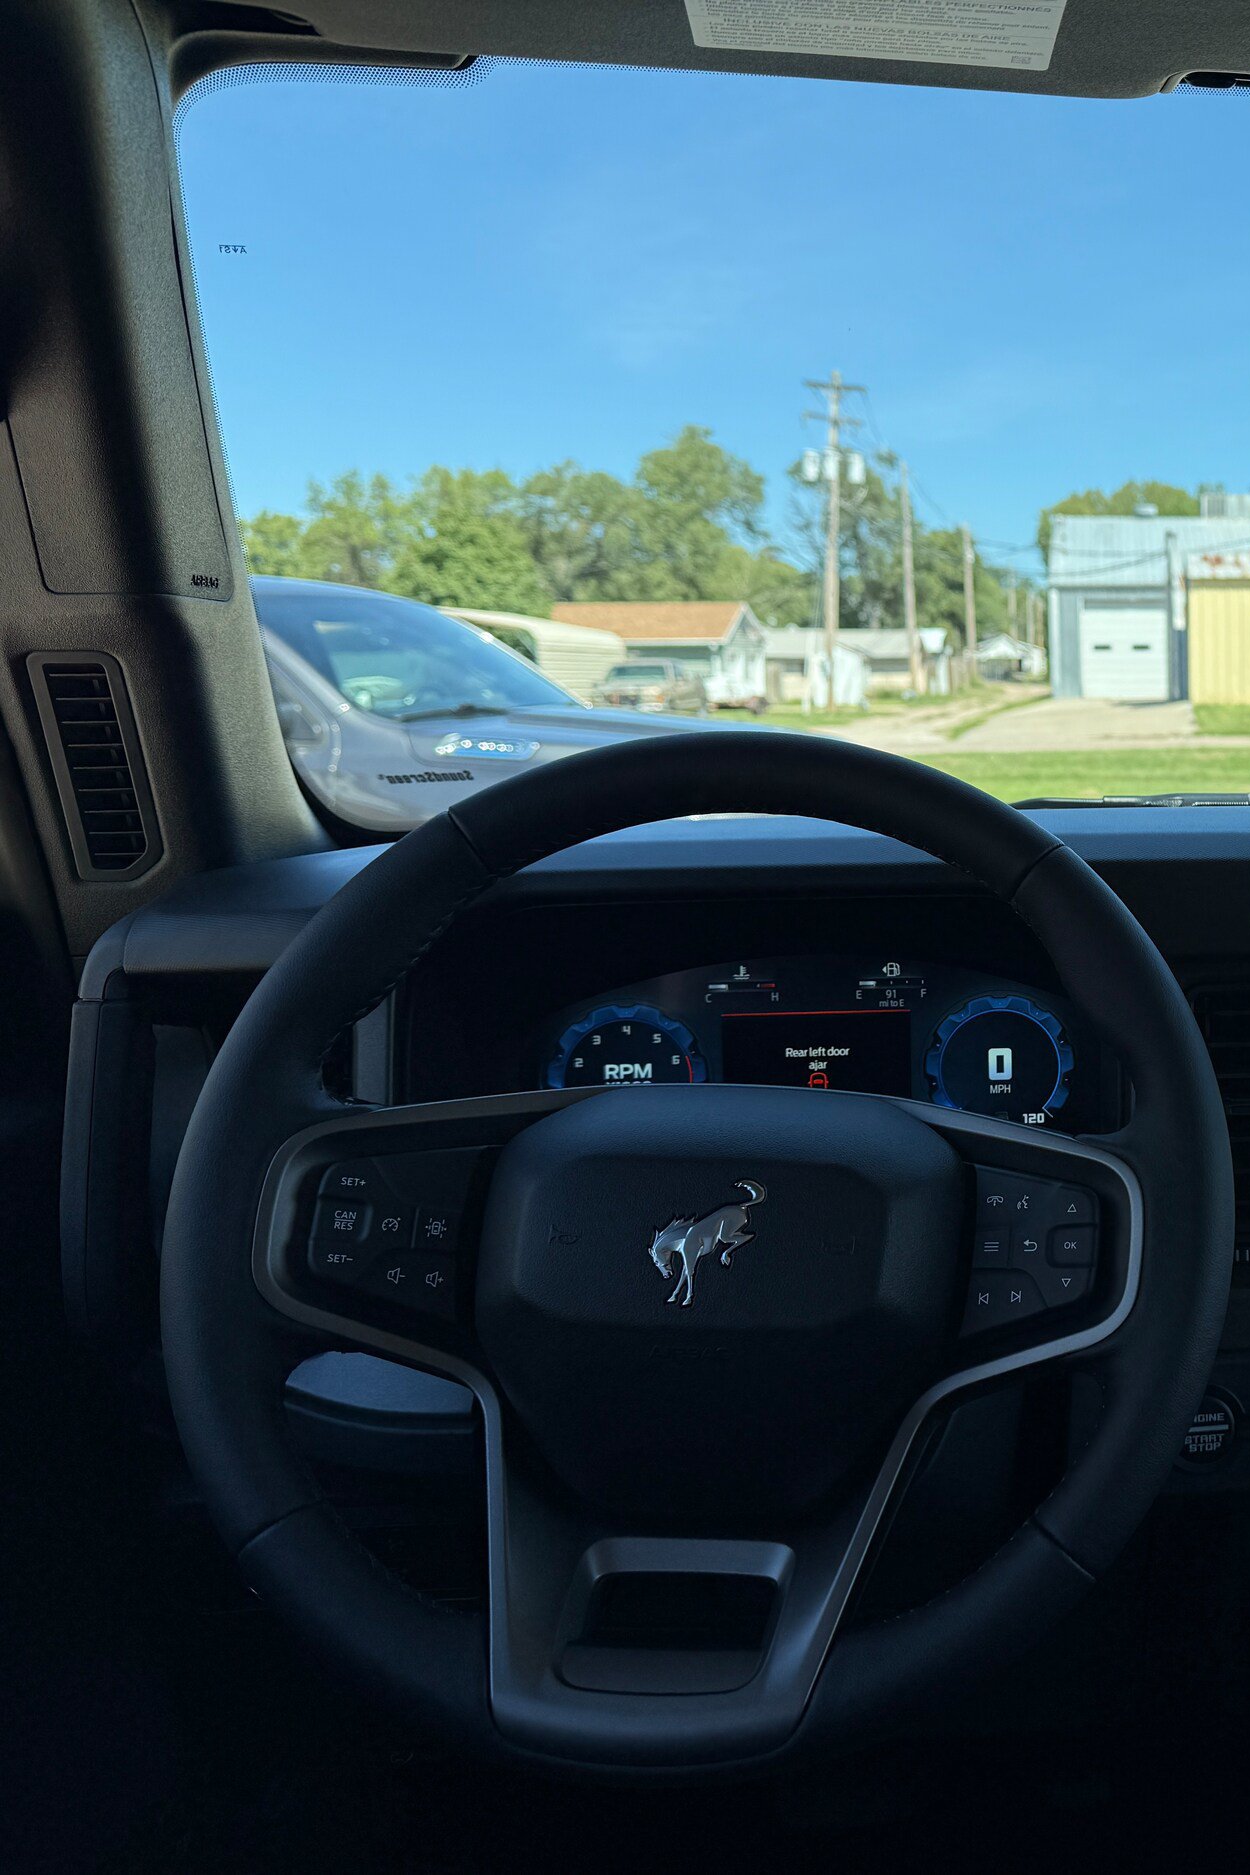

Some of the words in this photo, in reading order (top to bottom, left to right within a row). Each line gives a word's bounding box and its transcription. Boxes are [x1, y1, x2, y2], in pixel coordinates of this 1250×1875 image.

[856, 990, 862, 1000] E
[885, 989, 897, 999] 91
[921, 989, 927, 998] F
[622, 1025, 631, 1035] 4
[592, 1035, 601, 1045] 3
[652, 1034, 661, 1043] 5
[785, 1048, 808, 1058] Rear
[809, 1047, 826, 1057] left
[827, 1047, 850, 1056] door
[574, 1058, 584, 1067] 2
[672, 1055, 680, 1065] 6
[988, 1048, 1012, 1080] 0
[808, 1060, 828, 1071] ajar
[604, 1063, 653, 1080] RPM
[989, 1084, 1011, 1095] MPH
[1023, 1113, 1045, 1124] 120
[341, 1177, 366, 1186] SET+
[334, 1210, 357, 1220] CAN
[334, 1221, 353, 1231] RES
[1063, 1241, 1077, 1250] OK
[1189, 1442, 1221, 1452] STOP
